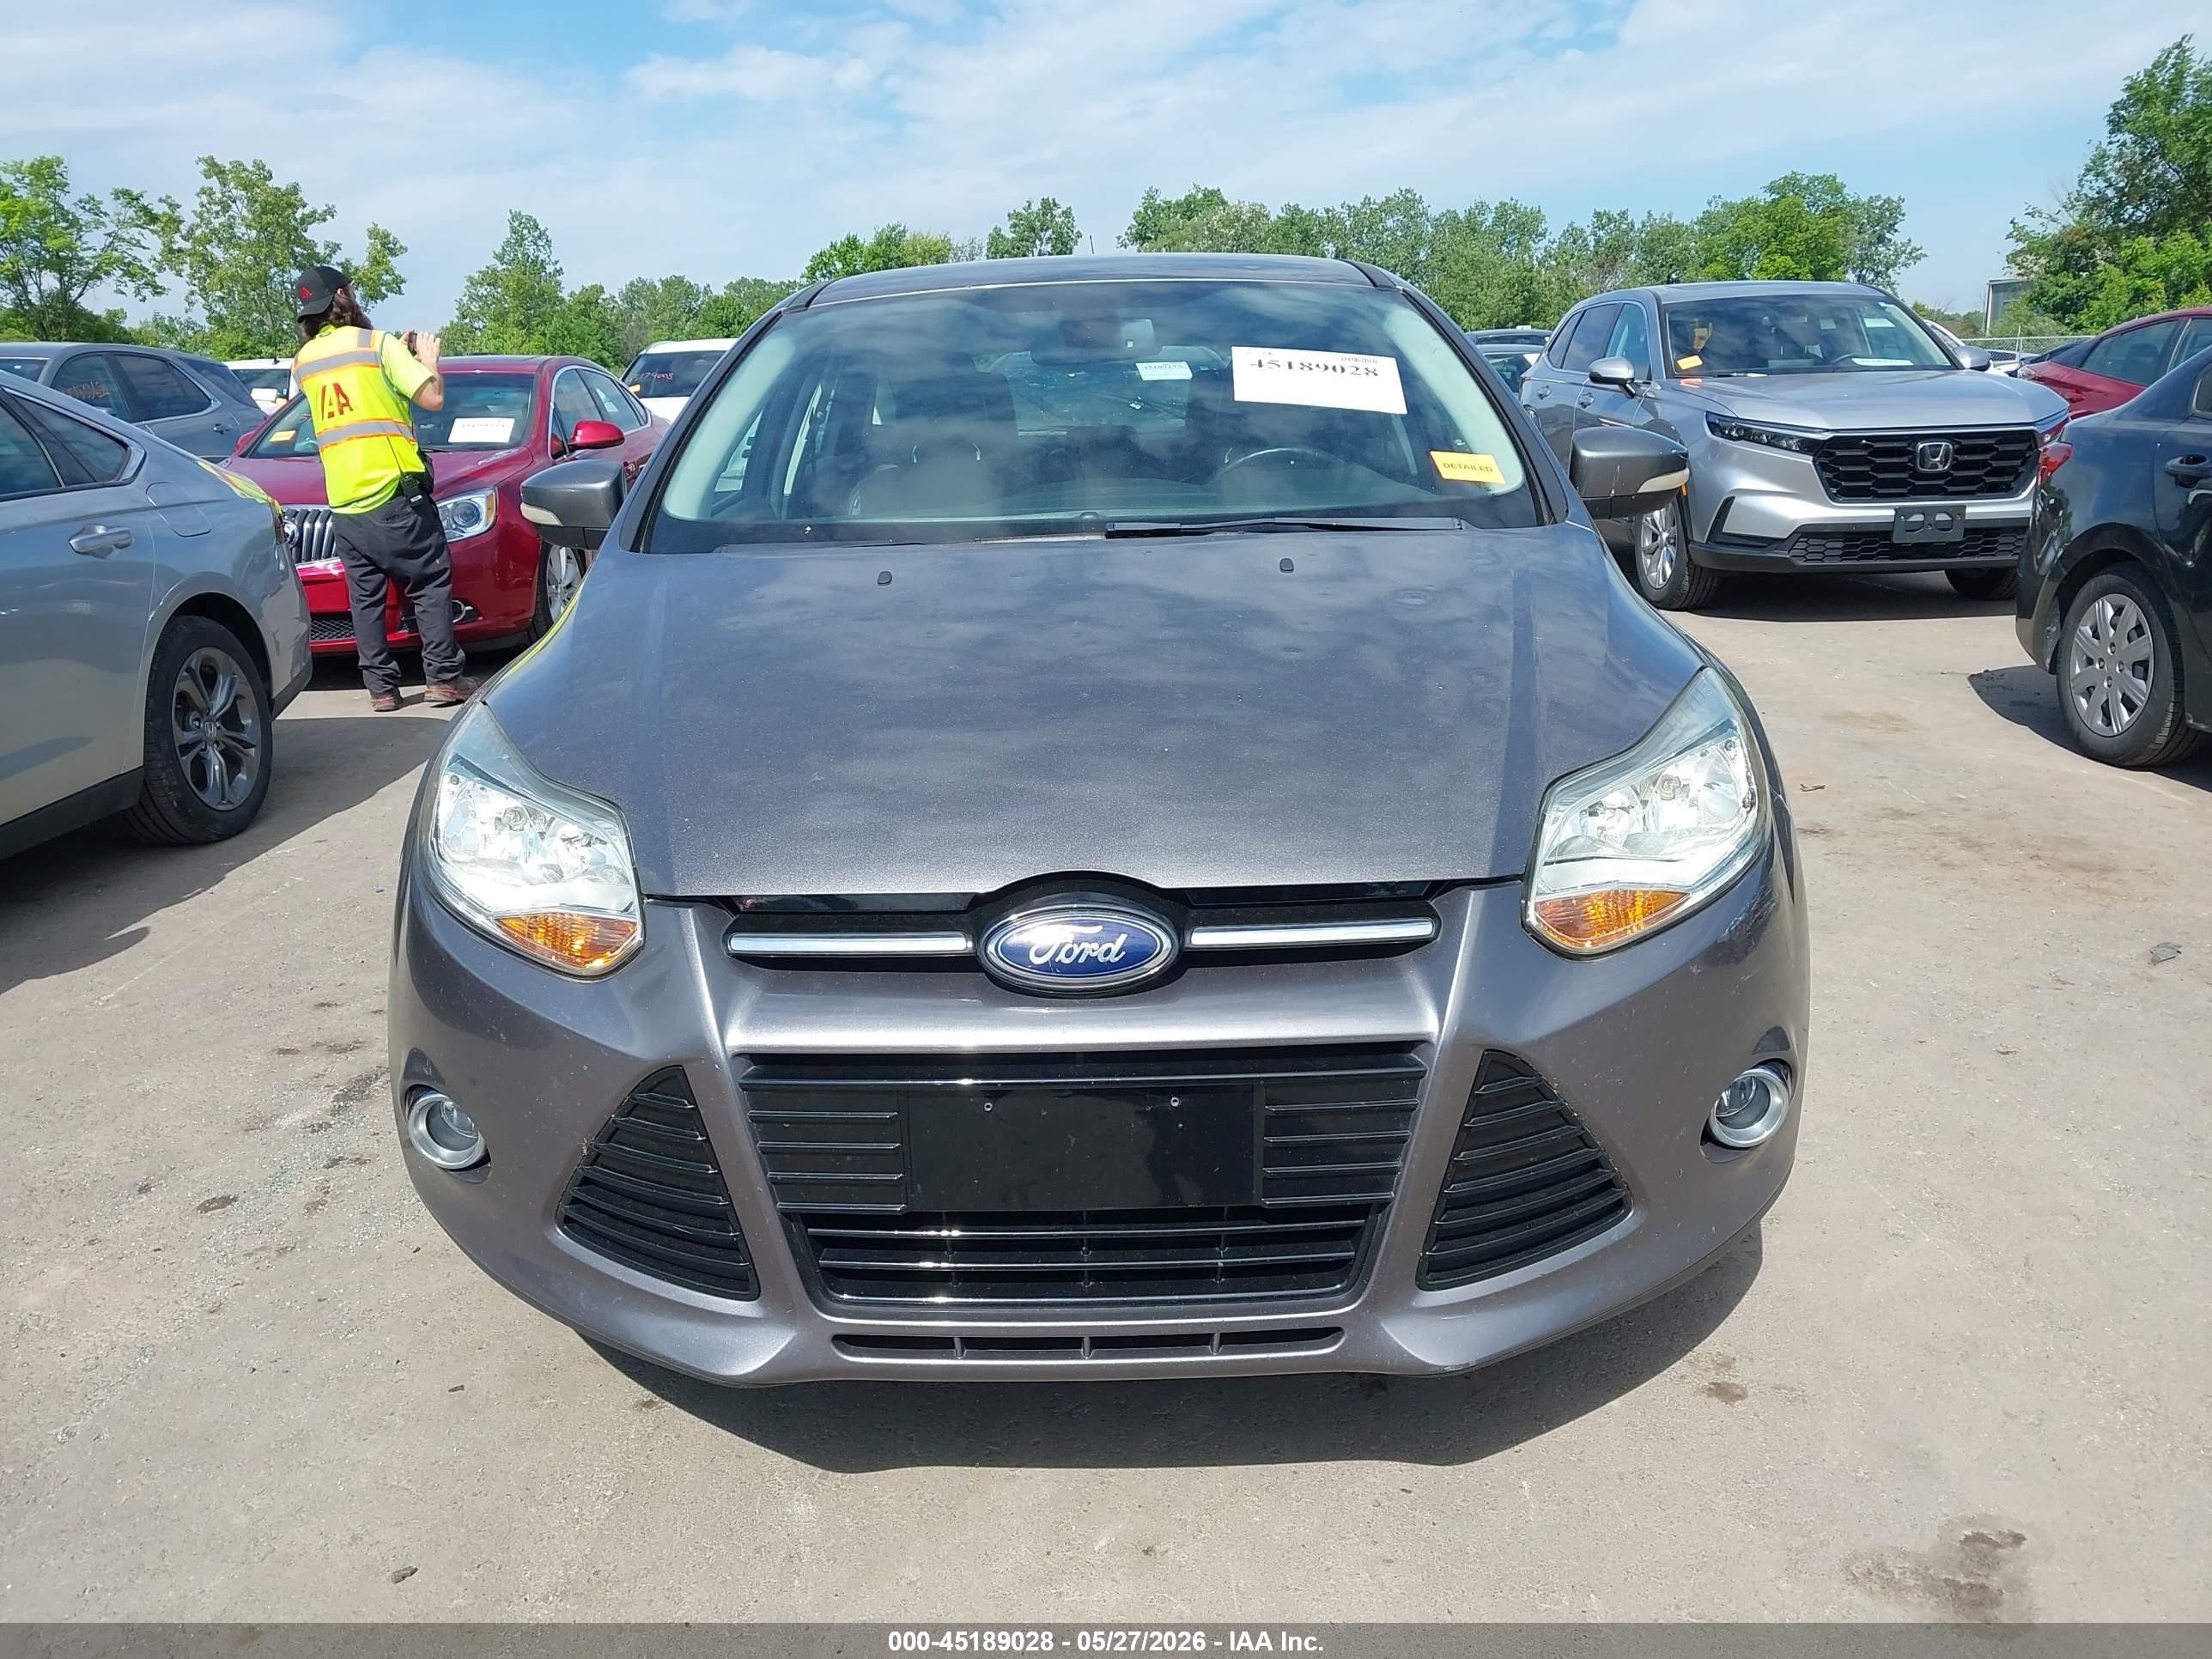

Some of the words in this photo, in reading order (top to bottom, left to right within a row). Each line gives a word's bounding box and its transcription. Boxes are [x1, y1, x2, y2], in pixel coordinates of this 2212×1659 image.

[1249, 358, 1379, 377] 45189028
[1443, 462, 1493, 472] DETAILED
[1029, 924, 1128, 965] Ford
